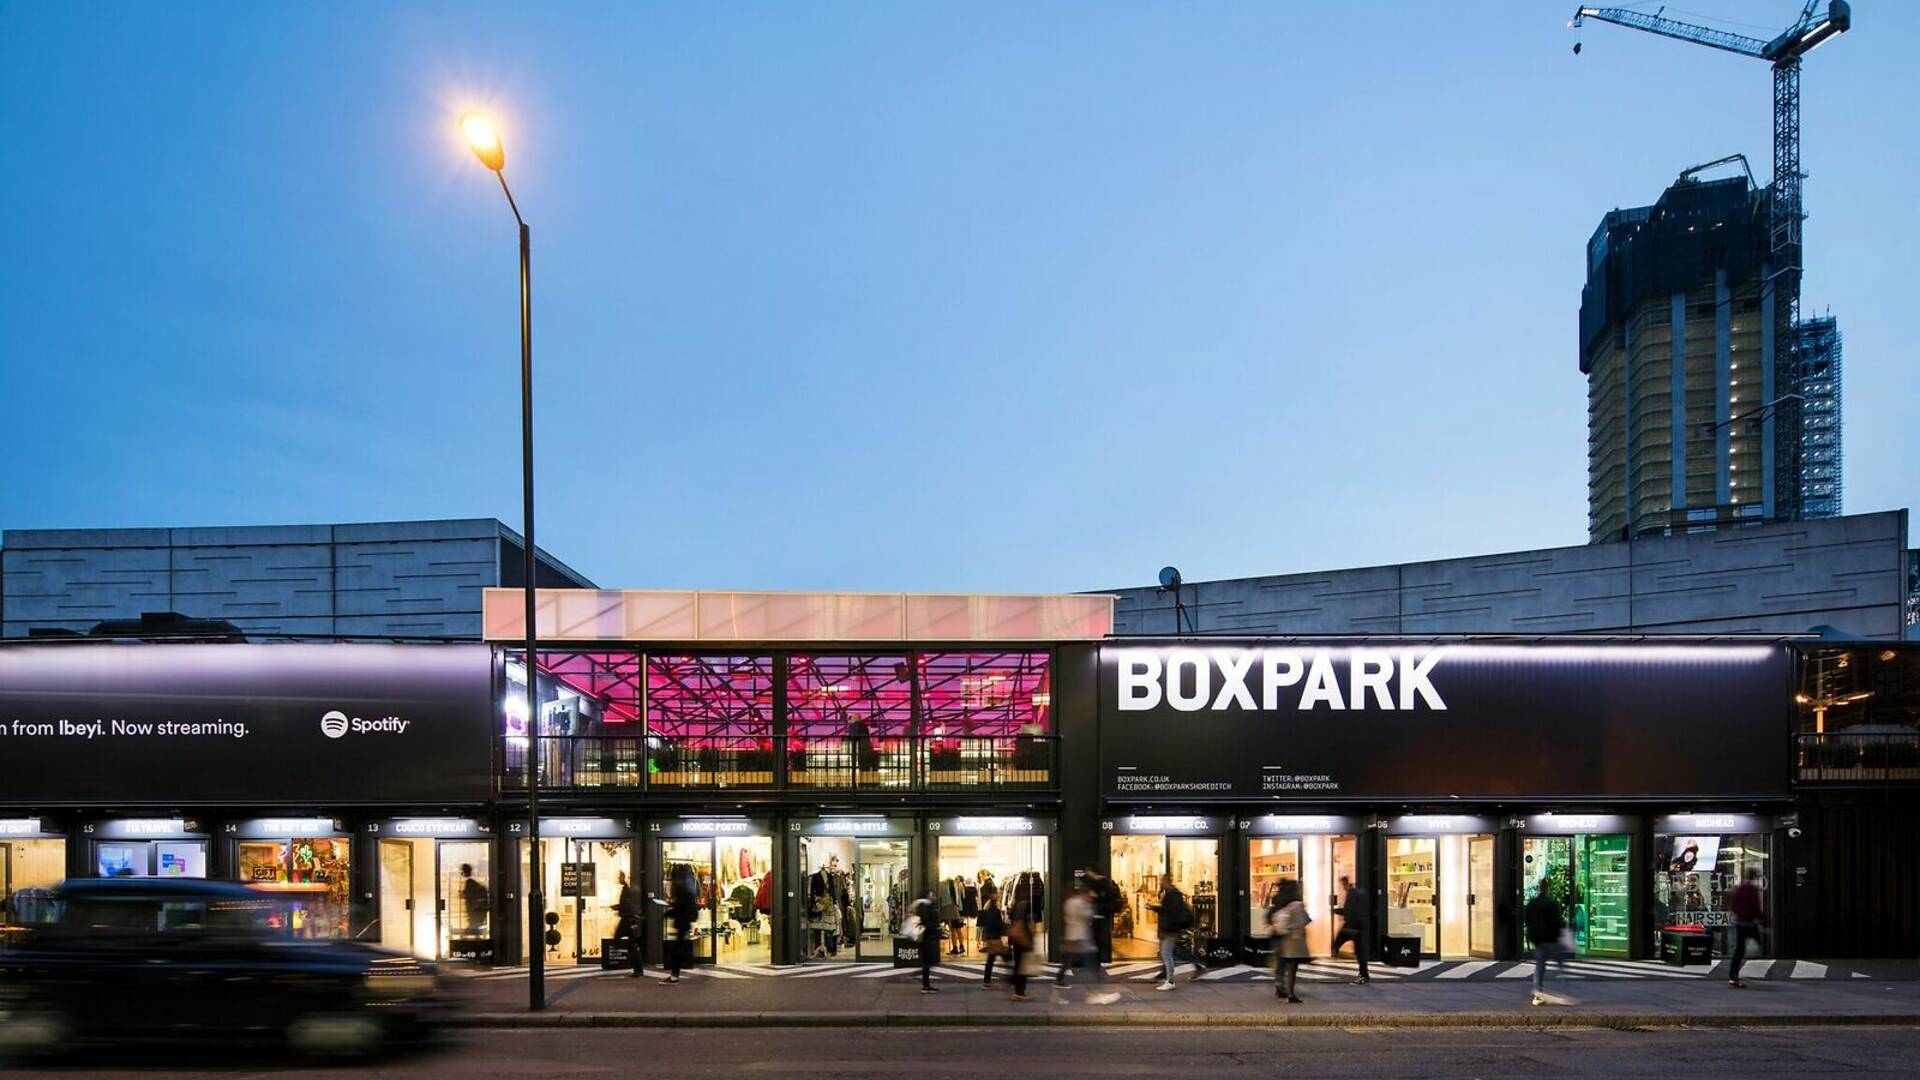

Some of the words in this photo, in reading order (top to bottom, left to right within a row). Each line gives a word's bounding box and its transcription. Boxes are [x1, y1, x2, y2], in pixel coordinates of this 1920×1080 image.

[1118, 649, 1447, 711] BOXPARK
[12, 719, 54, 735] from
[59, 719, 106, 738] Ibeyi.
[112, 719, 152, 735] Now
[158, 719, 250, 738] streaming.
[352, 717, 408, 734] Spotify
[1117, 775, 1170, 783] BOXPARK.CO.UK
[225, 824, 237, 832] 14
[368, 824, 379, 832] 13
[426, 824, 467, 832] EYEWEAR
[510, 824, 521, 832] 12
[651, 823, 661, 831] 11
[683, 823, 714, 832] NORDIC
[716, 823, 747, 832] POETRY
[791, 823, 800, 831] 10
[862, 822, 888, 831] STYLE
[929, 822, 940, 831] 09
[1102, 822, 1113, 830] 08
[1195, 820, 1208, 830] CO.
[1240, 821, 1250, 829] 07
[1378, 820, 1388, 828] 06
[83, 824, 95, 833] 15
